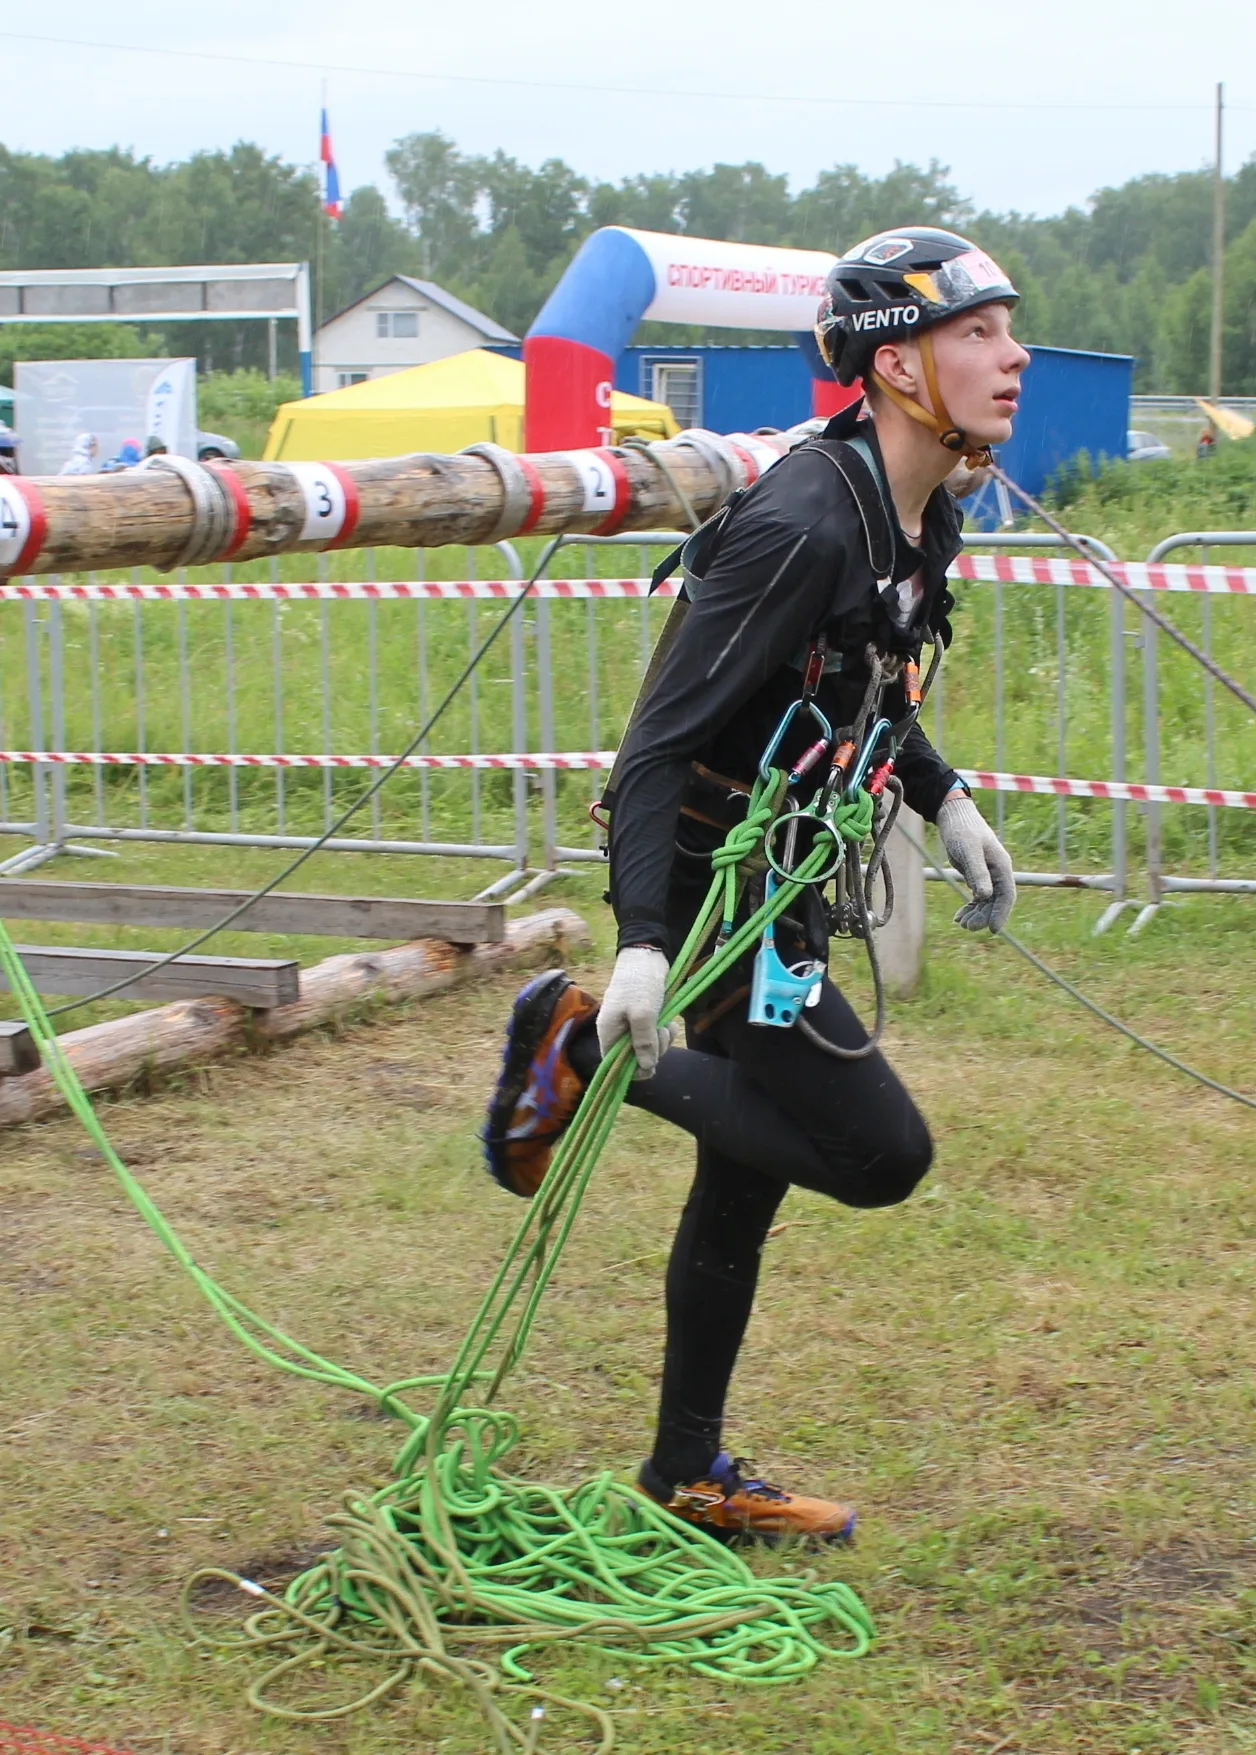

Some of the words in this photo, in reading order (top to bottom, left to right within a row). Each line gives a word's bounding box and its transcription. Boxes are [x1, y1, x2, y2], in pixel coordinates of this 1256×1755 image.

[668, 264, 778, 294] СПОРТИВНЫЙ
[852, 304, 920, 332] VENTO
[590, 466, 607, 498] 2
[315, 480, 333, 519] 3
